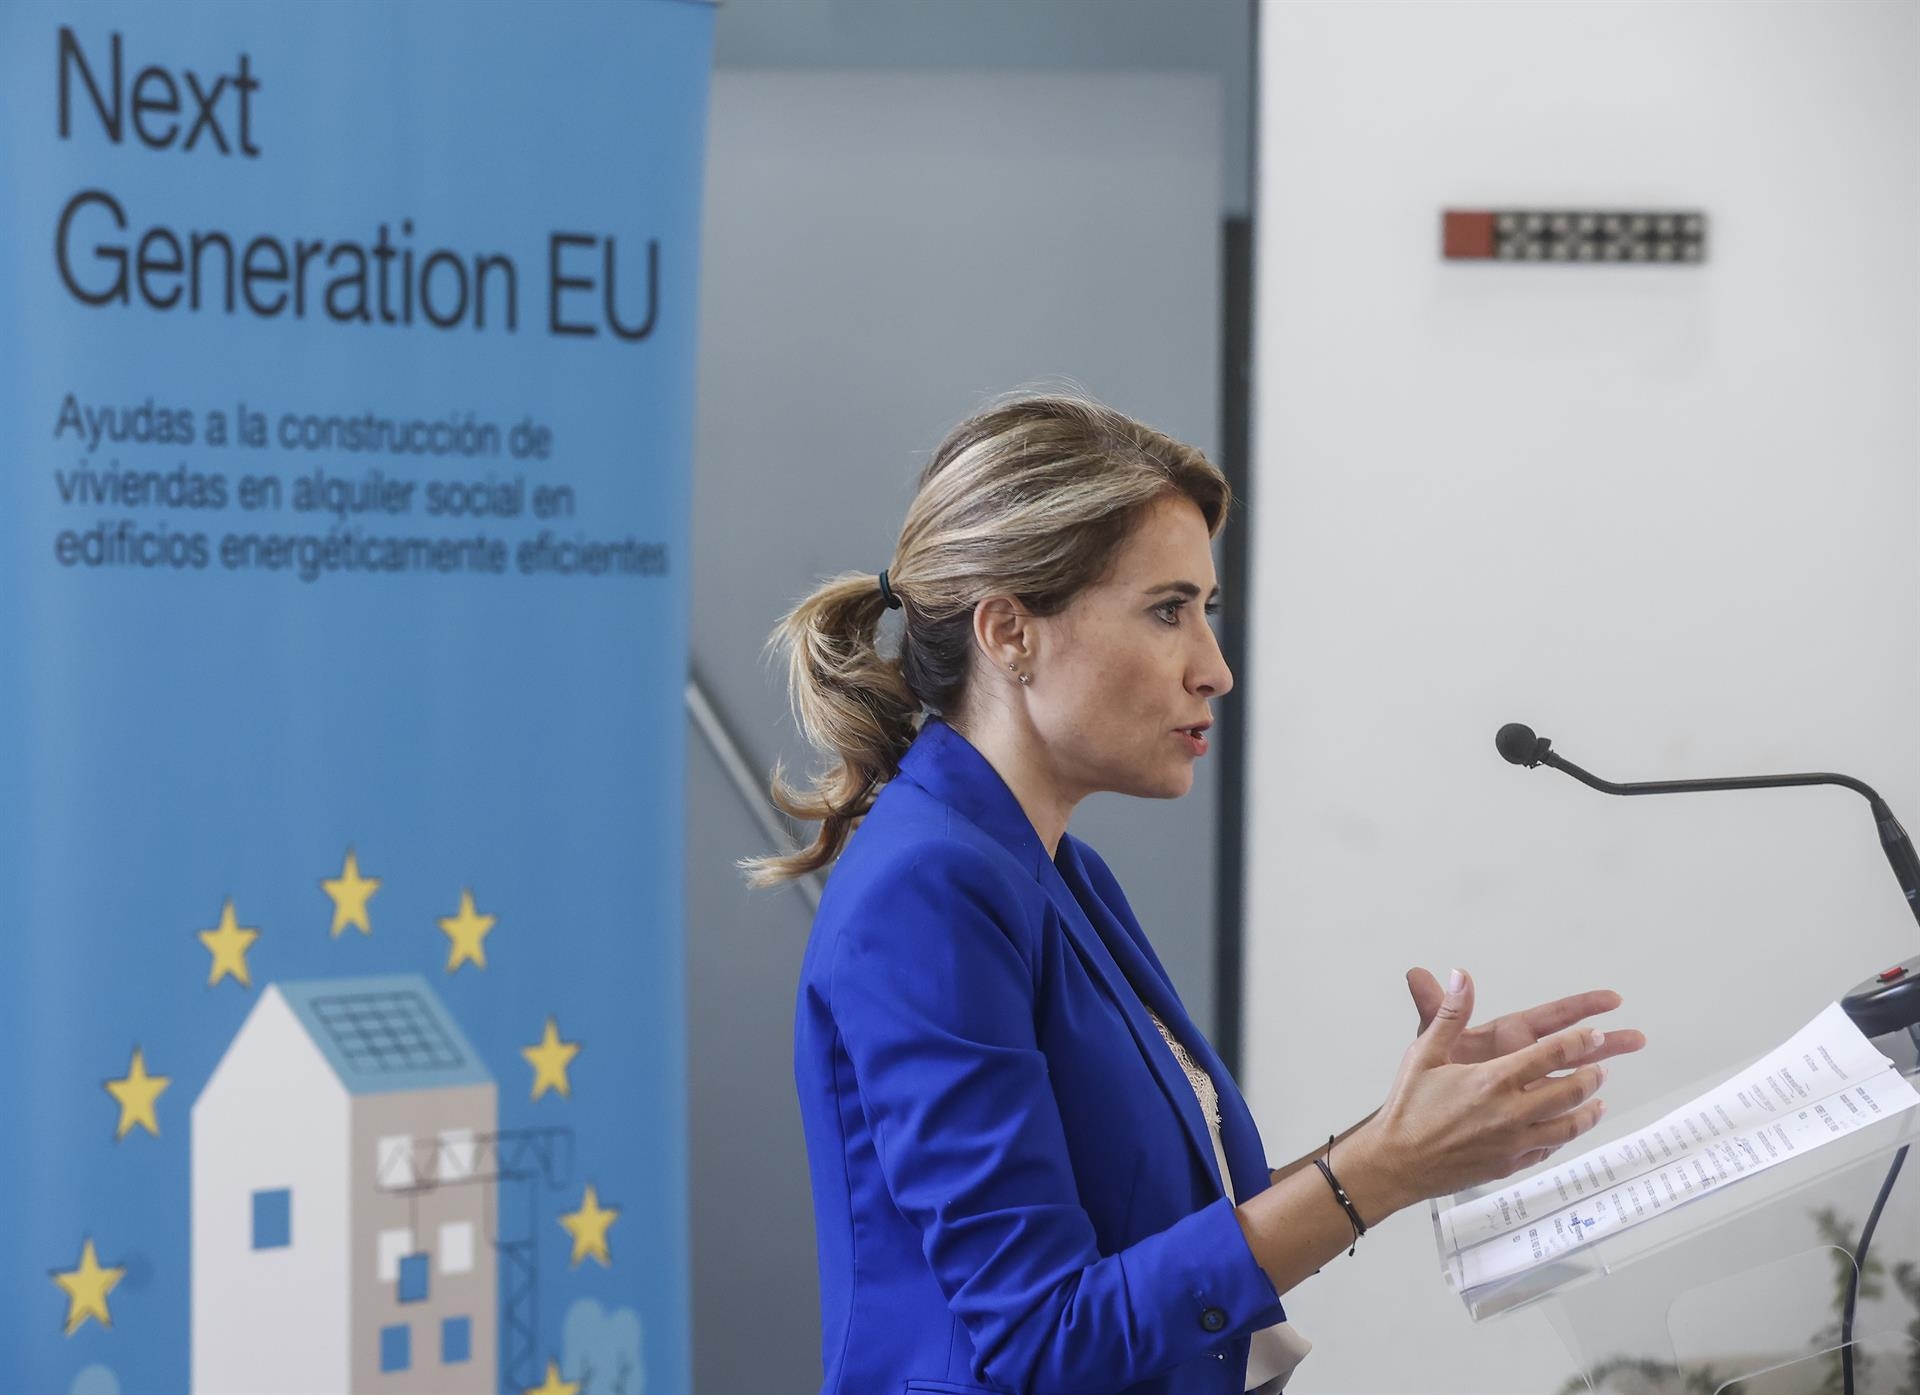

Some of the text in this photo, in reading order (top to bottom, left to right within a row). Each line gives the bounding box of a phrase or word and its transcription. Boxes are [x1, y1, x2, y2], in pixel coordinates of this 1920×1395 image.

[58, 26, 261, 158] Next
[55, 190, 660, 342] Generation EU
[54, 394, 553, 460] Ayudas a la construcción de
[54, 458, 576, 521] viviendas en alquiler social en
[55, 519, 670, 583] edificios energéticamente eficientes
